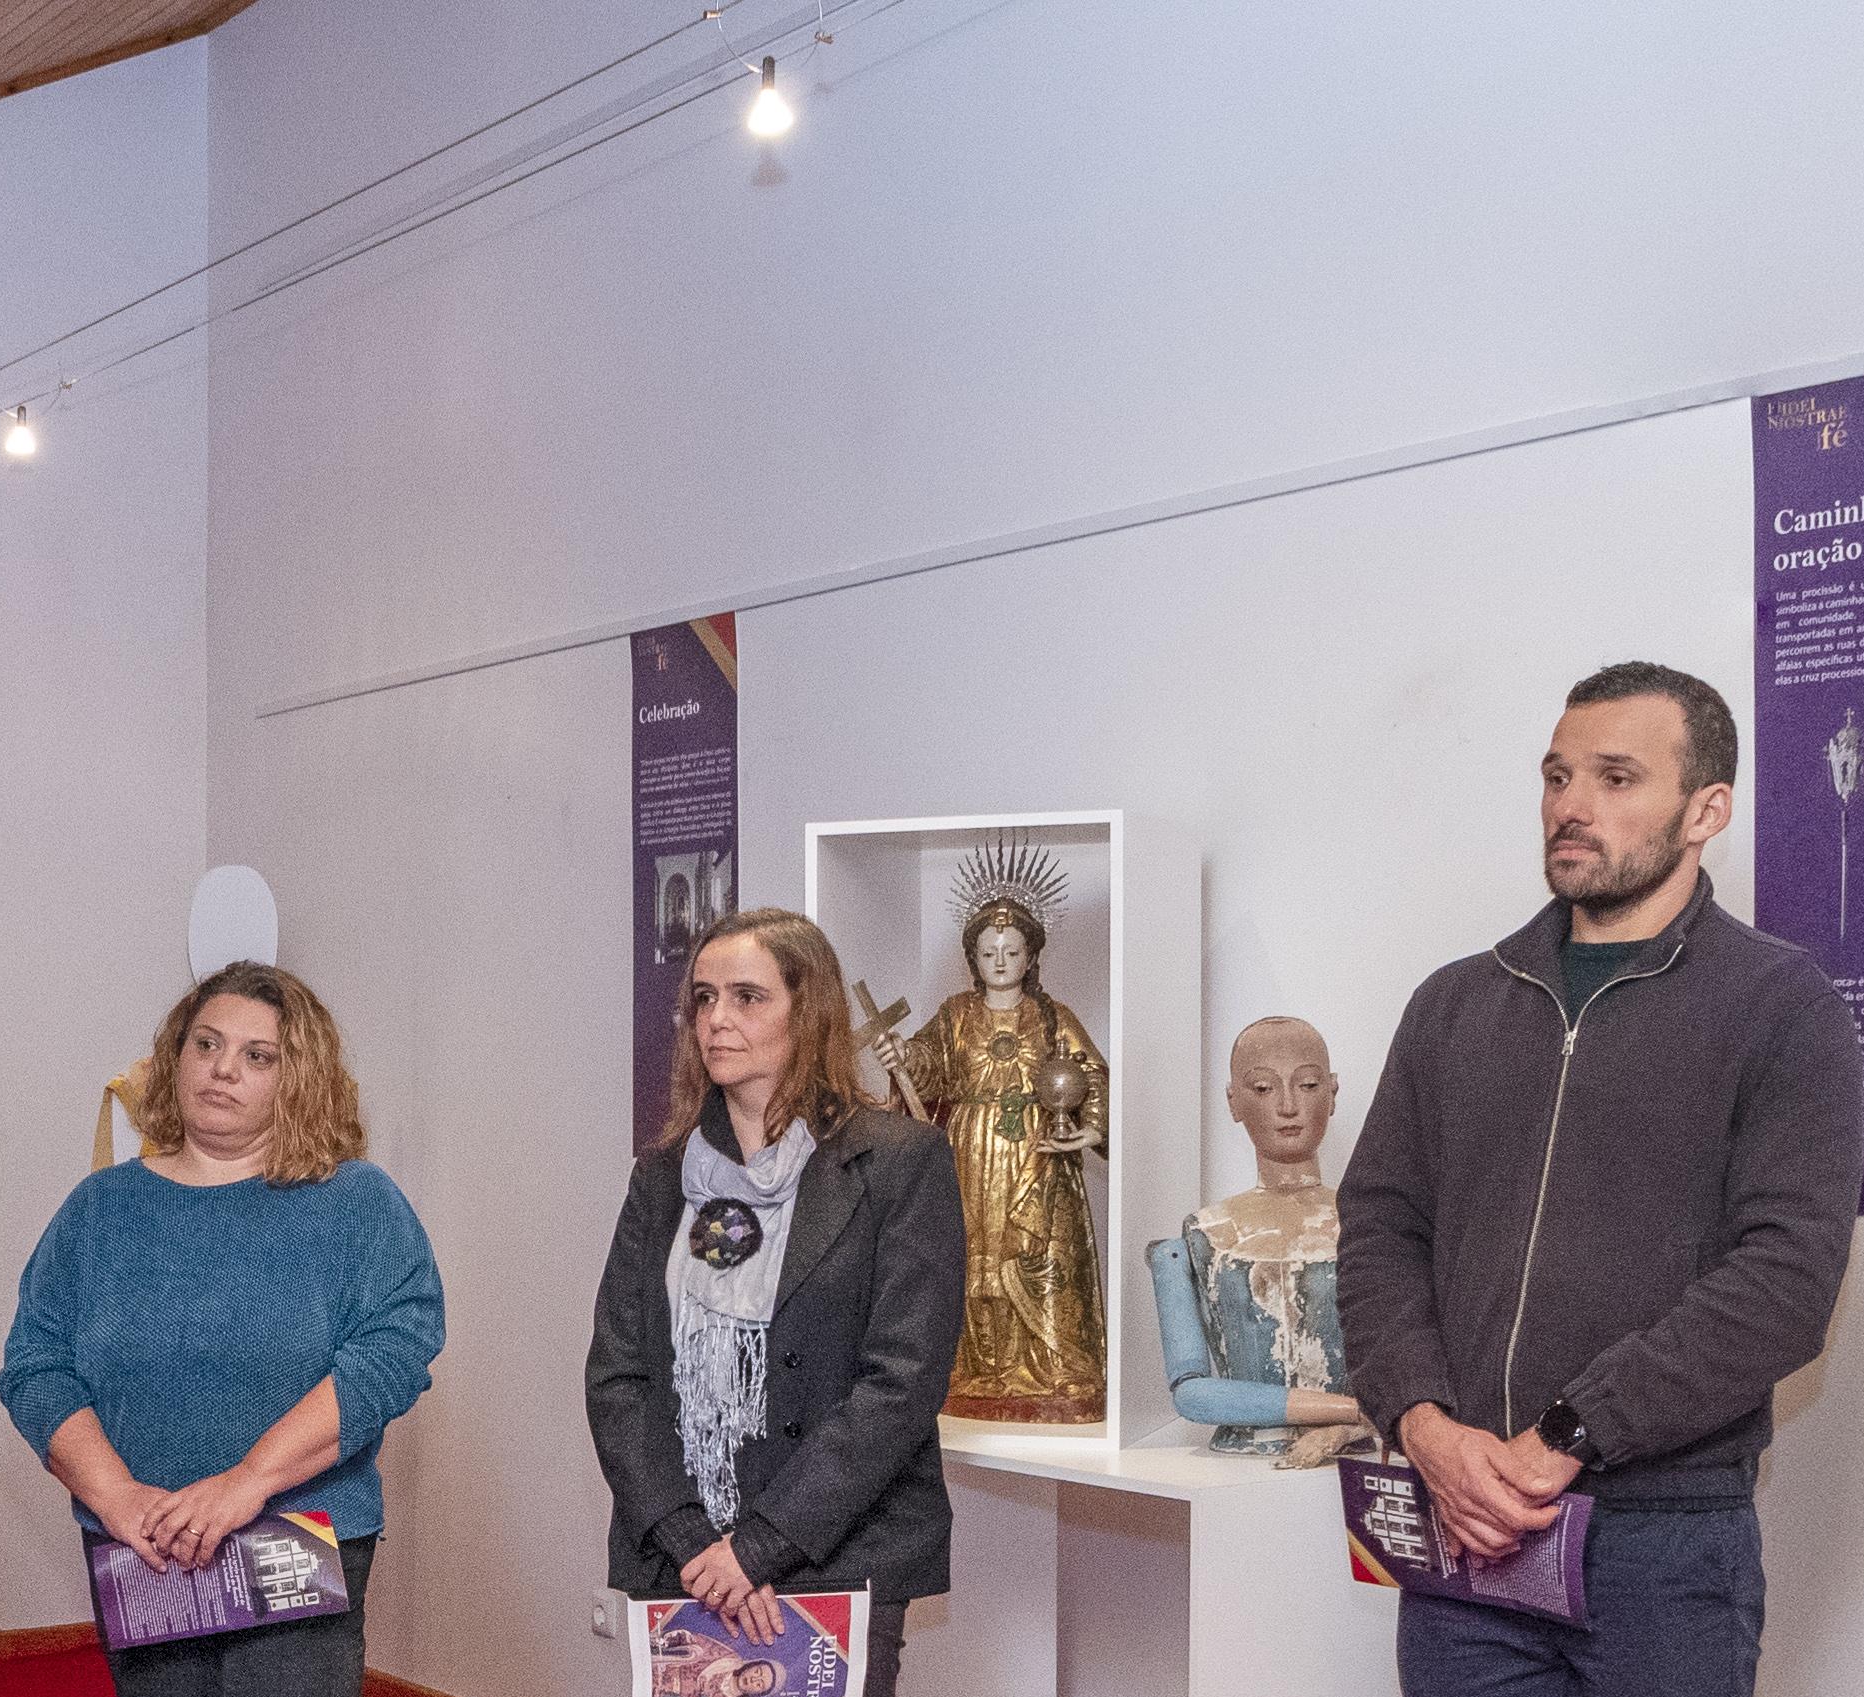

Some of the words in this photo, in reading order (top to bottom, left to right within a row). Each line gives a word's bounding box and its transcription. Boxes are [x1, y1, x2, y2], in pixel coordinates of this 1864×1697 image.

[1821, 421, 1848, 450] fé
[1772, 538, 1863, 571] oração
[638, 699, 701, 724] Celebração
[820, 1634, 838, 1689] FIDEI
